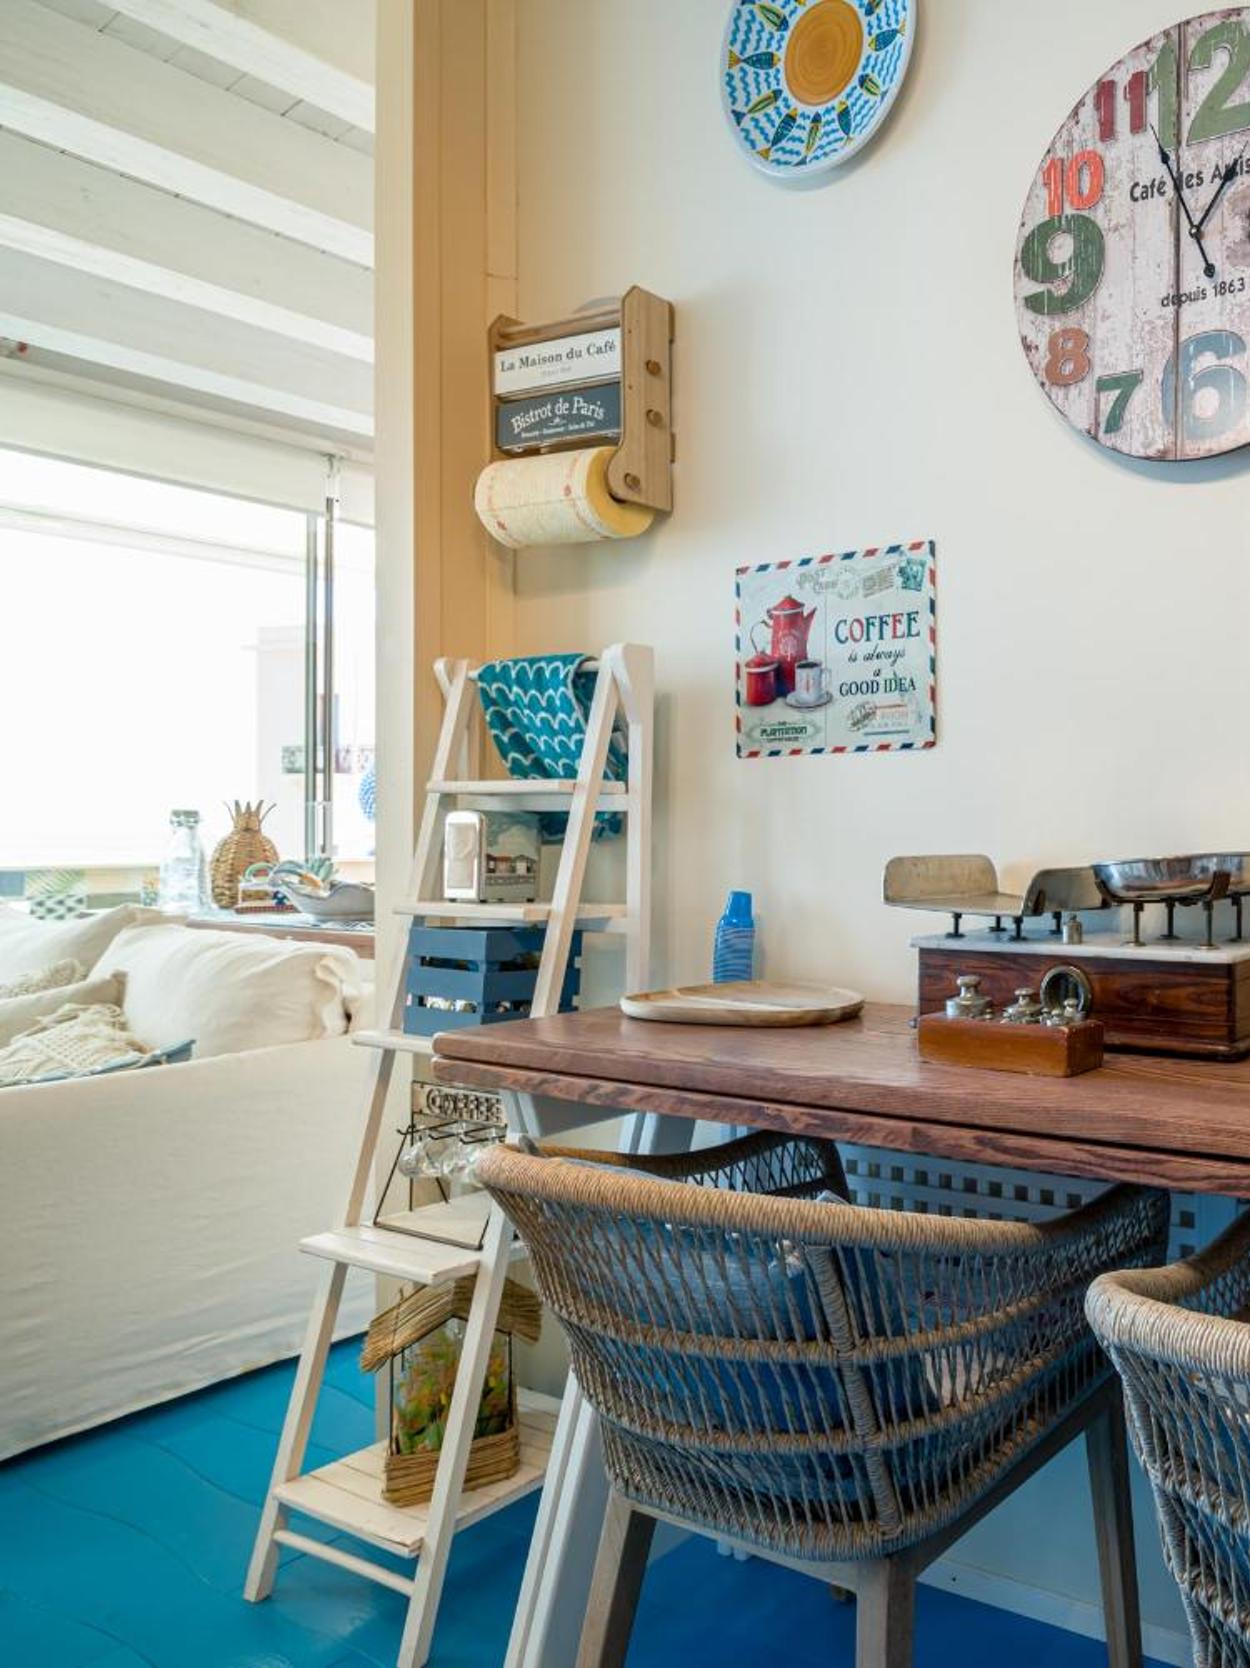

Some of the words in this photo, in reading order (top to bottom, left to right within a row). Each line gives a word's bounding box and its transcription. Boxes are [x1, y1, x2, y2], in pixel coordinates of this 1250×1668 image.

[1093, 70, 1147, 143] 11
[1041, 149, 1105, 217] 10
[1129, 174, 1168, 202] Café
[1021, 214, 1106, 316] 9
[1161, 286, 1208, 309] depuis
[1212, 276, 1246, 299] 1863
[500, 360, 515, 372] La
[519, 351, 563, 369] Maison
[566, 347, 582, 360] du
[586, 340, 616, 357] Café
[1044, 327, 1090, 387] 8
[1096, 370, 1144, 434] 7
[1161, 329, 1249, 440] 6
[510, 401, 553, 435] Bistrot
[555, 396, 570, 415] de
[572, 396, 605, 420] Paris
[834, 610, 921, 645] COFFEE
[847, 648, 858, 663] is
[863, 643, 905, 667] always
[839, 679, 879, 698] GOOD
[883, 674, 917, 694] IDEA
